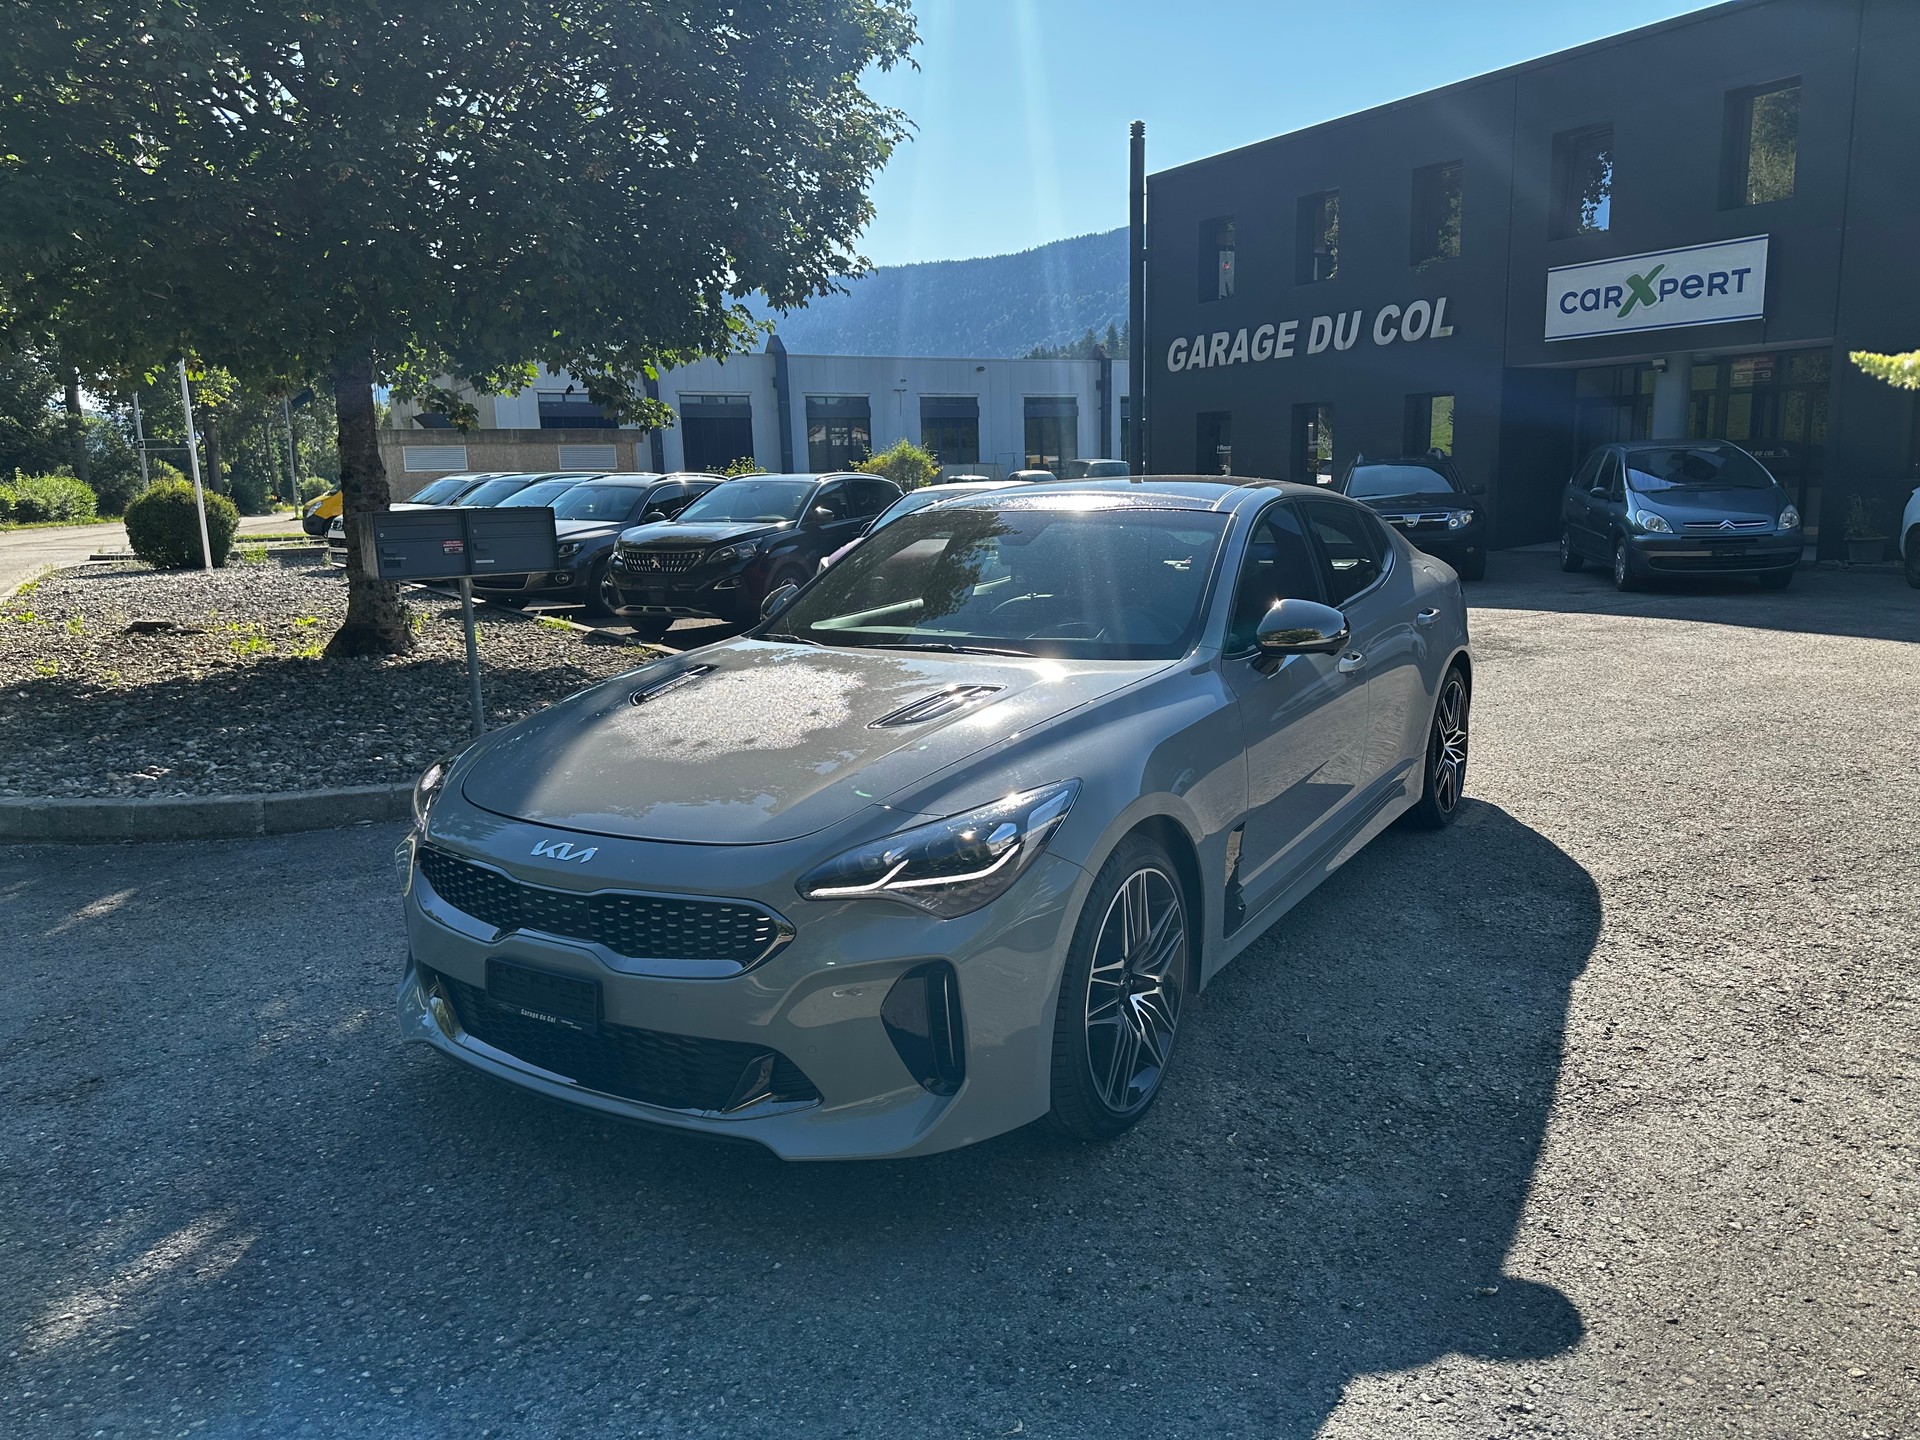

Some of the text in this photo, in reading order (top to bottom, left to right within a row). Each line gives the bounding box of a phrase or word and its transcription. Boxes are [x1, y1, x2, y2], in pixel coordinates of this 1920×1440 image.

[1167, 297, 1454, 372] GARAGE DU COL
[520, 1008, 539, 1019] Garage
